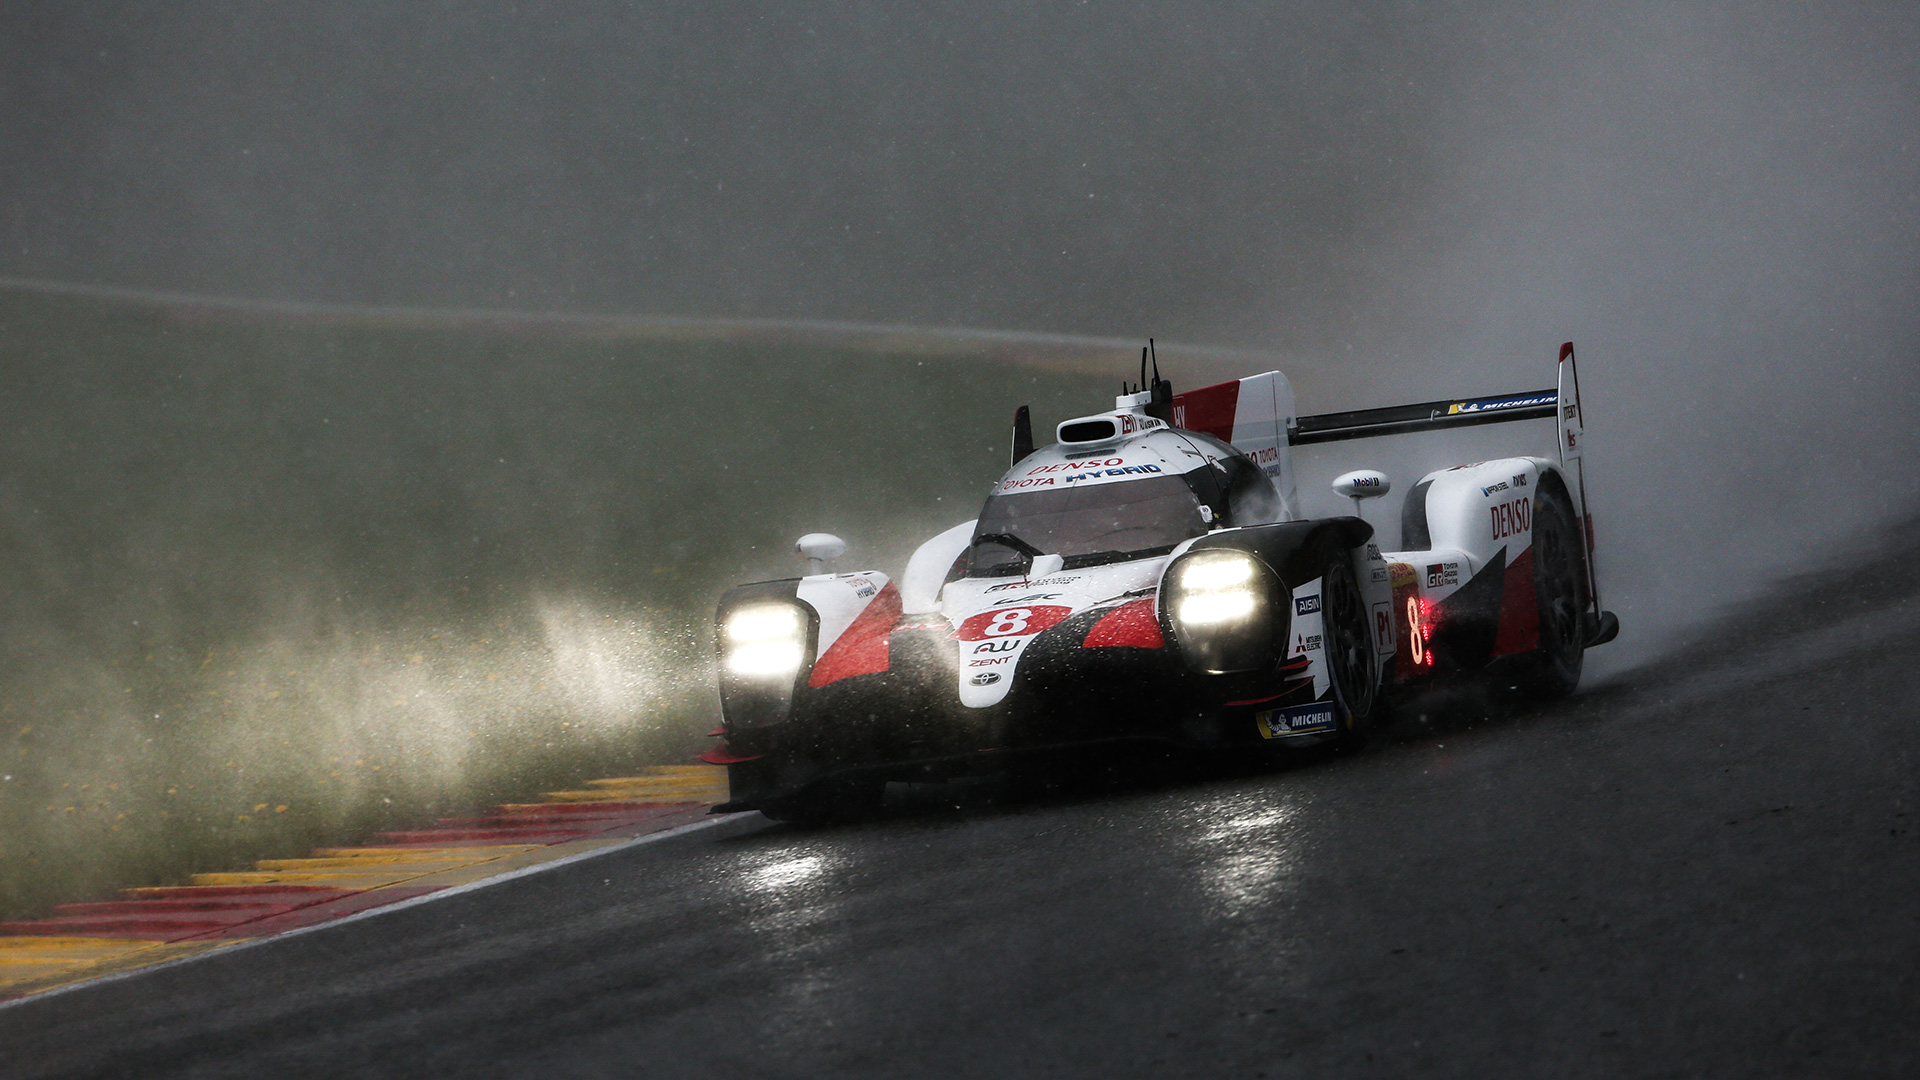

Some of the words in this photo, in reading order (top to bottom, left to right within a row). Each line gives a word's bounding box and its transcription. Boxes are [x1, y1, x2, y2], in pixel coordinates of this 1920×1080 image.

[1482, 396, 1558, 410] MICHELIN
[1259, 447, 1278, 463] TOYOTA
[1027, 458, 1124, 476] DENSO
[1000, 477, 1055, 490] TOYOTA
[1066, 464, 1162, 483] HYBRID
[1353, 477, 1374, 487] Mobil
[1490, 497, 1530, 540] DENSO
[1299, 598, 1320, 612] AISIN
[984, 608, 1033, 636] 8
[1377, 610, 1392, 646] P1
[1407, 596, 1423, 665] 8
[968, 655, 1013, 667] ZENT
[1291, 712, 1332, 727] MICHELIN
